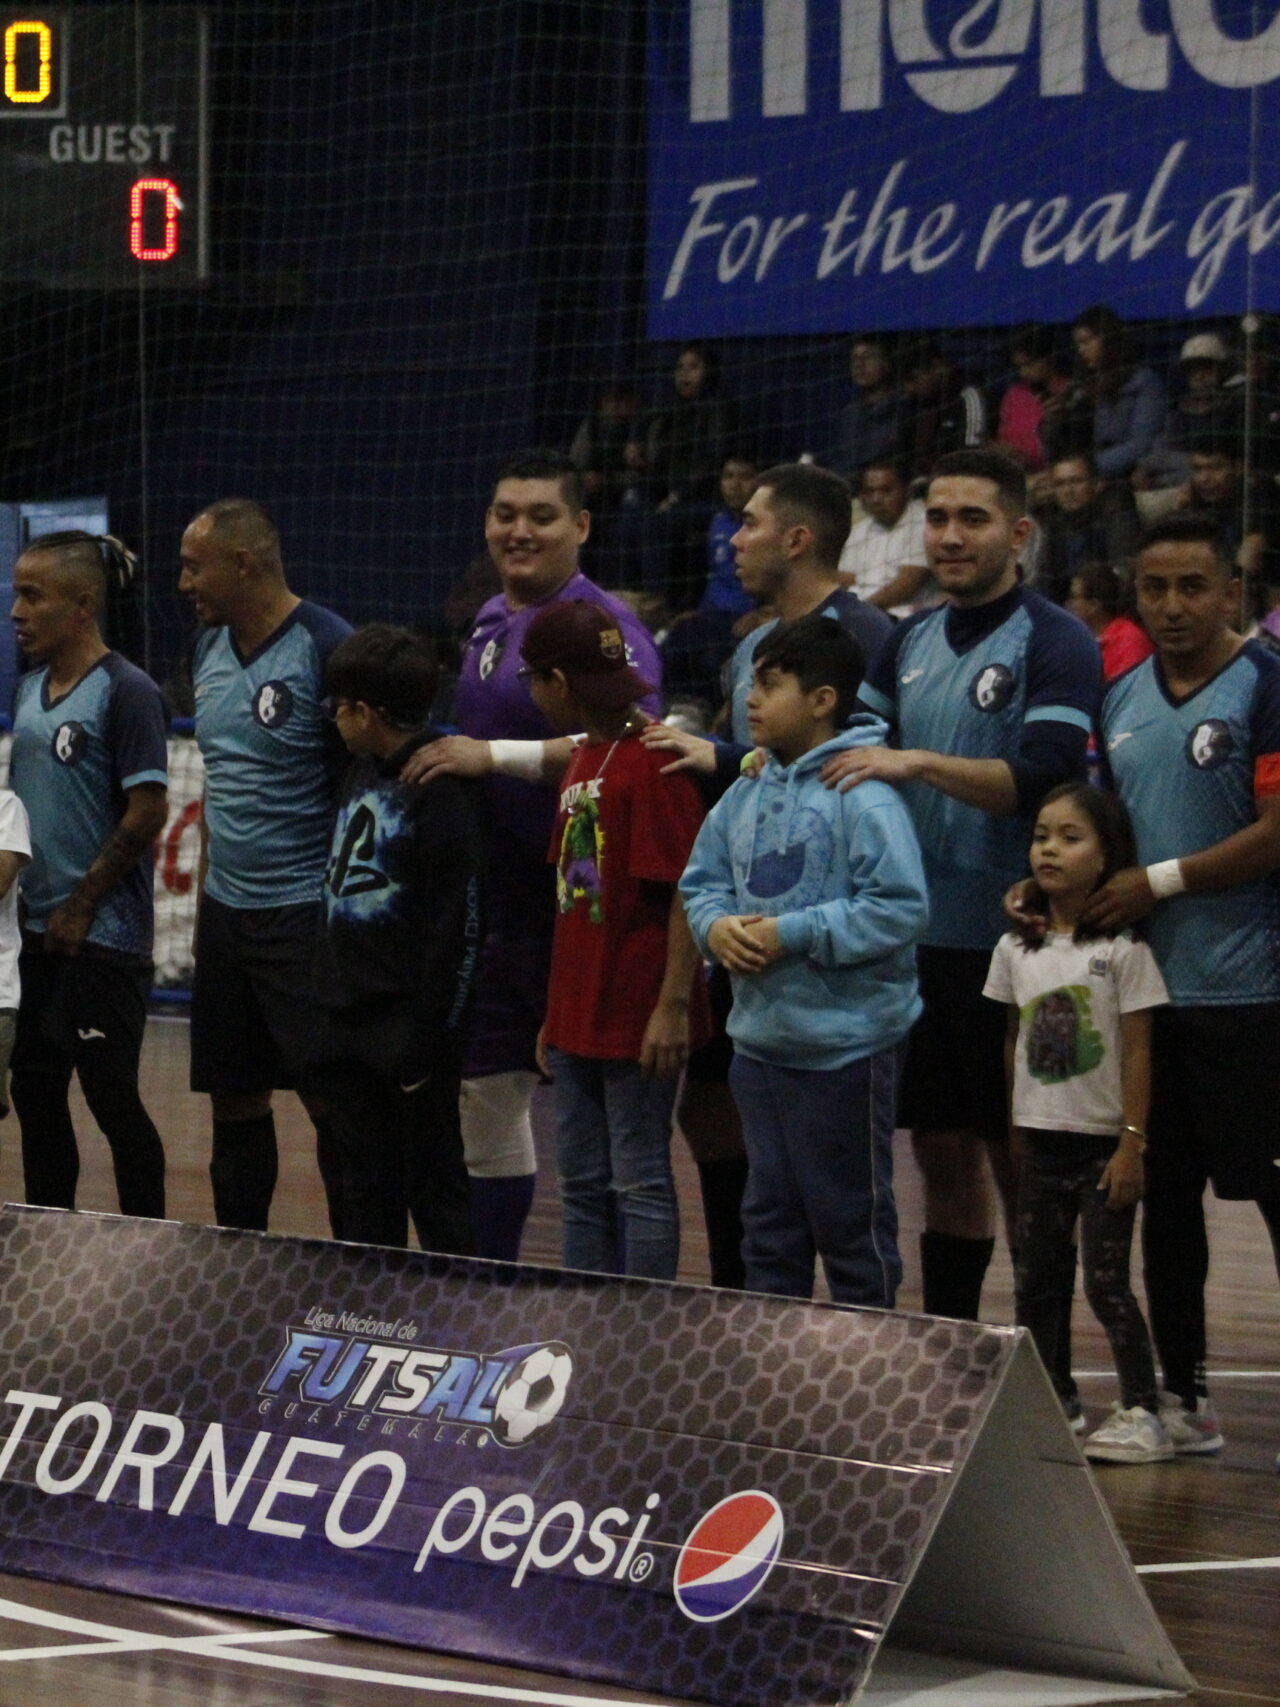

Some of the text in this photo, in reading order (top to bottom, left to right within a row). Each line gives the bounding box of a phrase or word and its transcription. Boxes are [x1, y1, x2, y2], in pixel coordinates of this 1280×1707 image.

[48, 123, 177, 165] GUEST
[131, 178, 179, 260] 0
[662, 176, 810, 301] For
[815, 158, 966, 281] the
[974, 138, 1189, 273] real
[304, 1306, 419, 1341] Liga Nacional de
[263, 1331, 513, 1424] FUTSAL
[258, 1401, 469, 1447] GUATEMALA
